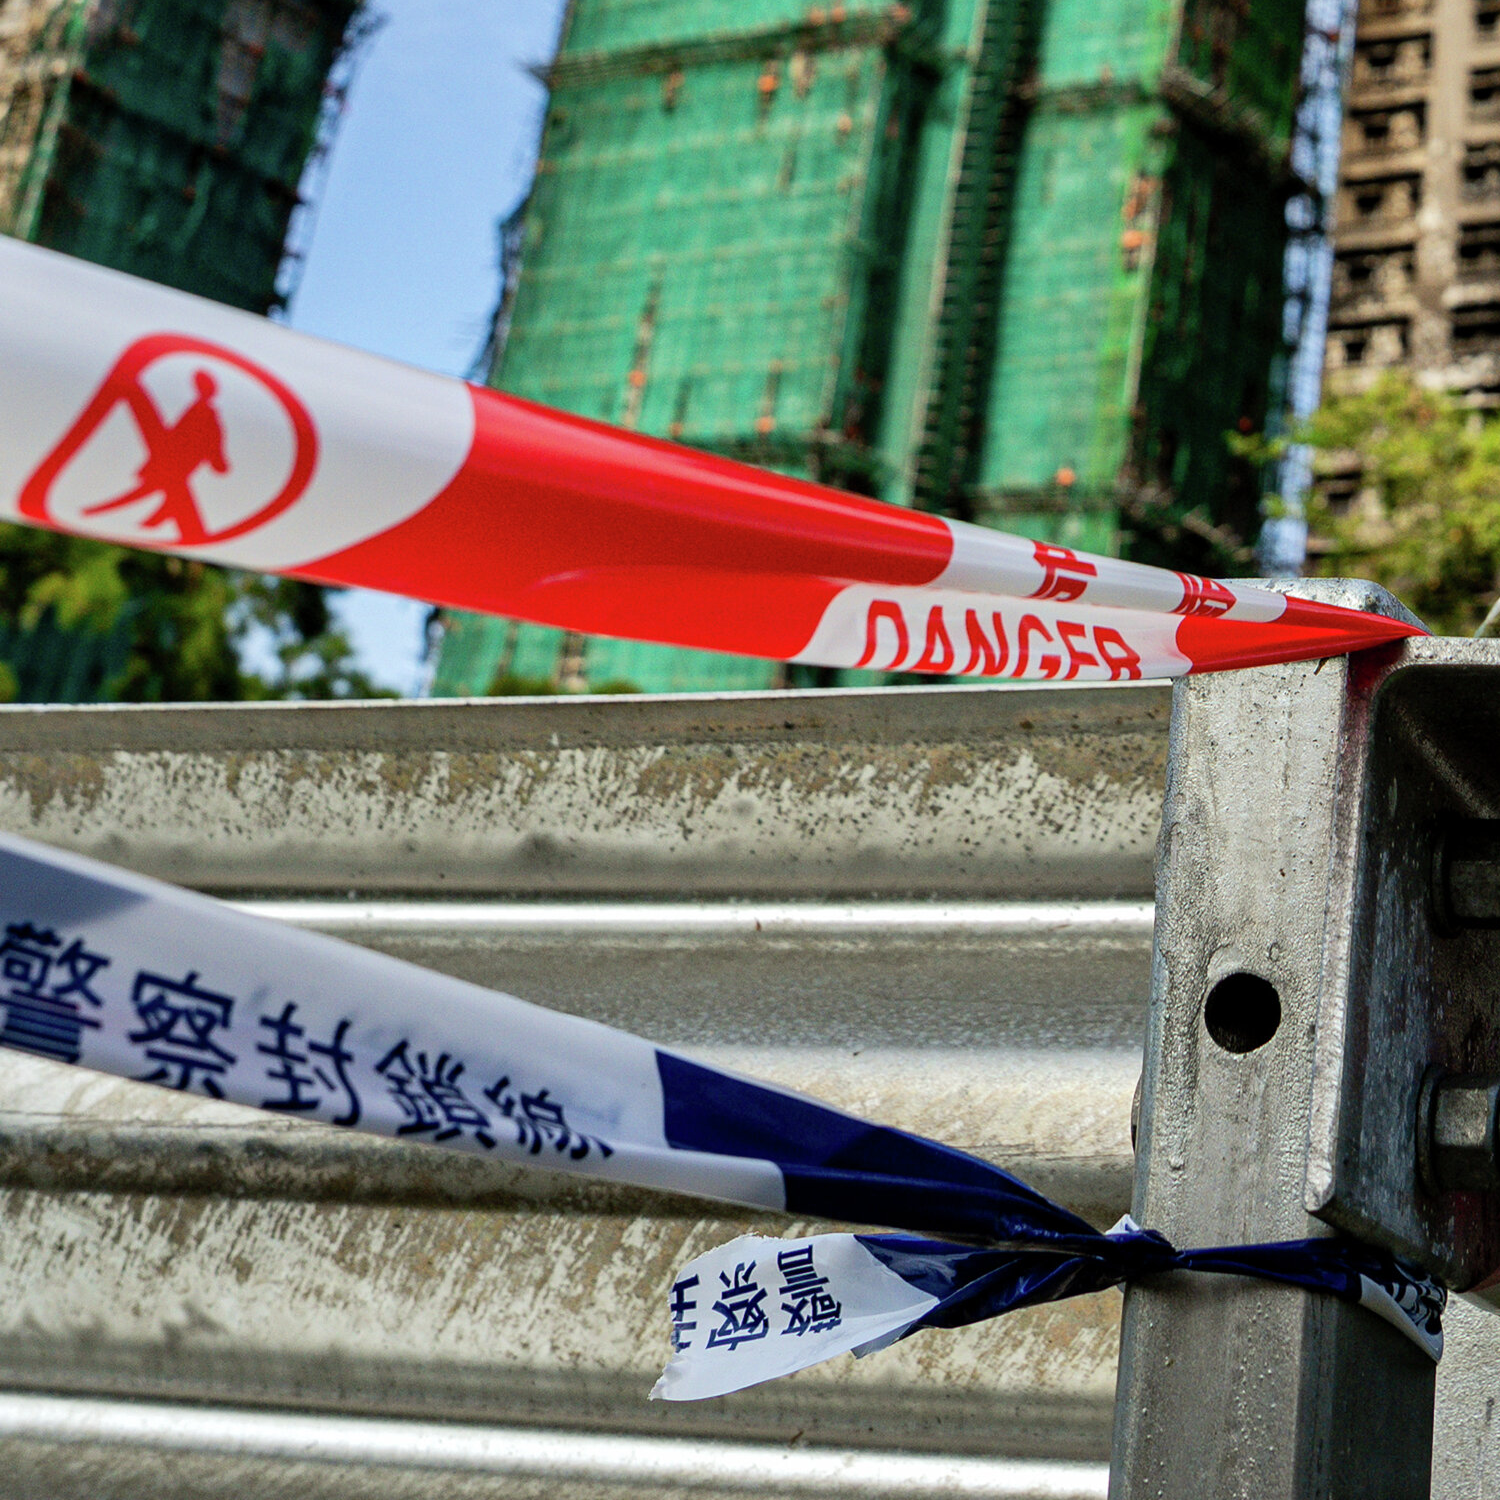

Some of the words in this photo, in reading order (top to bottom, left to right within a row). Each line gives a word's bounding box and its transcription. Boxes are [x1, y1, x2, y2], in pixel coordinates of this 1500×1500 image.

[853, 599, 1142, 681] DANGER
[0, 921, 614, 1161] 警察封鎖線
